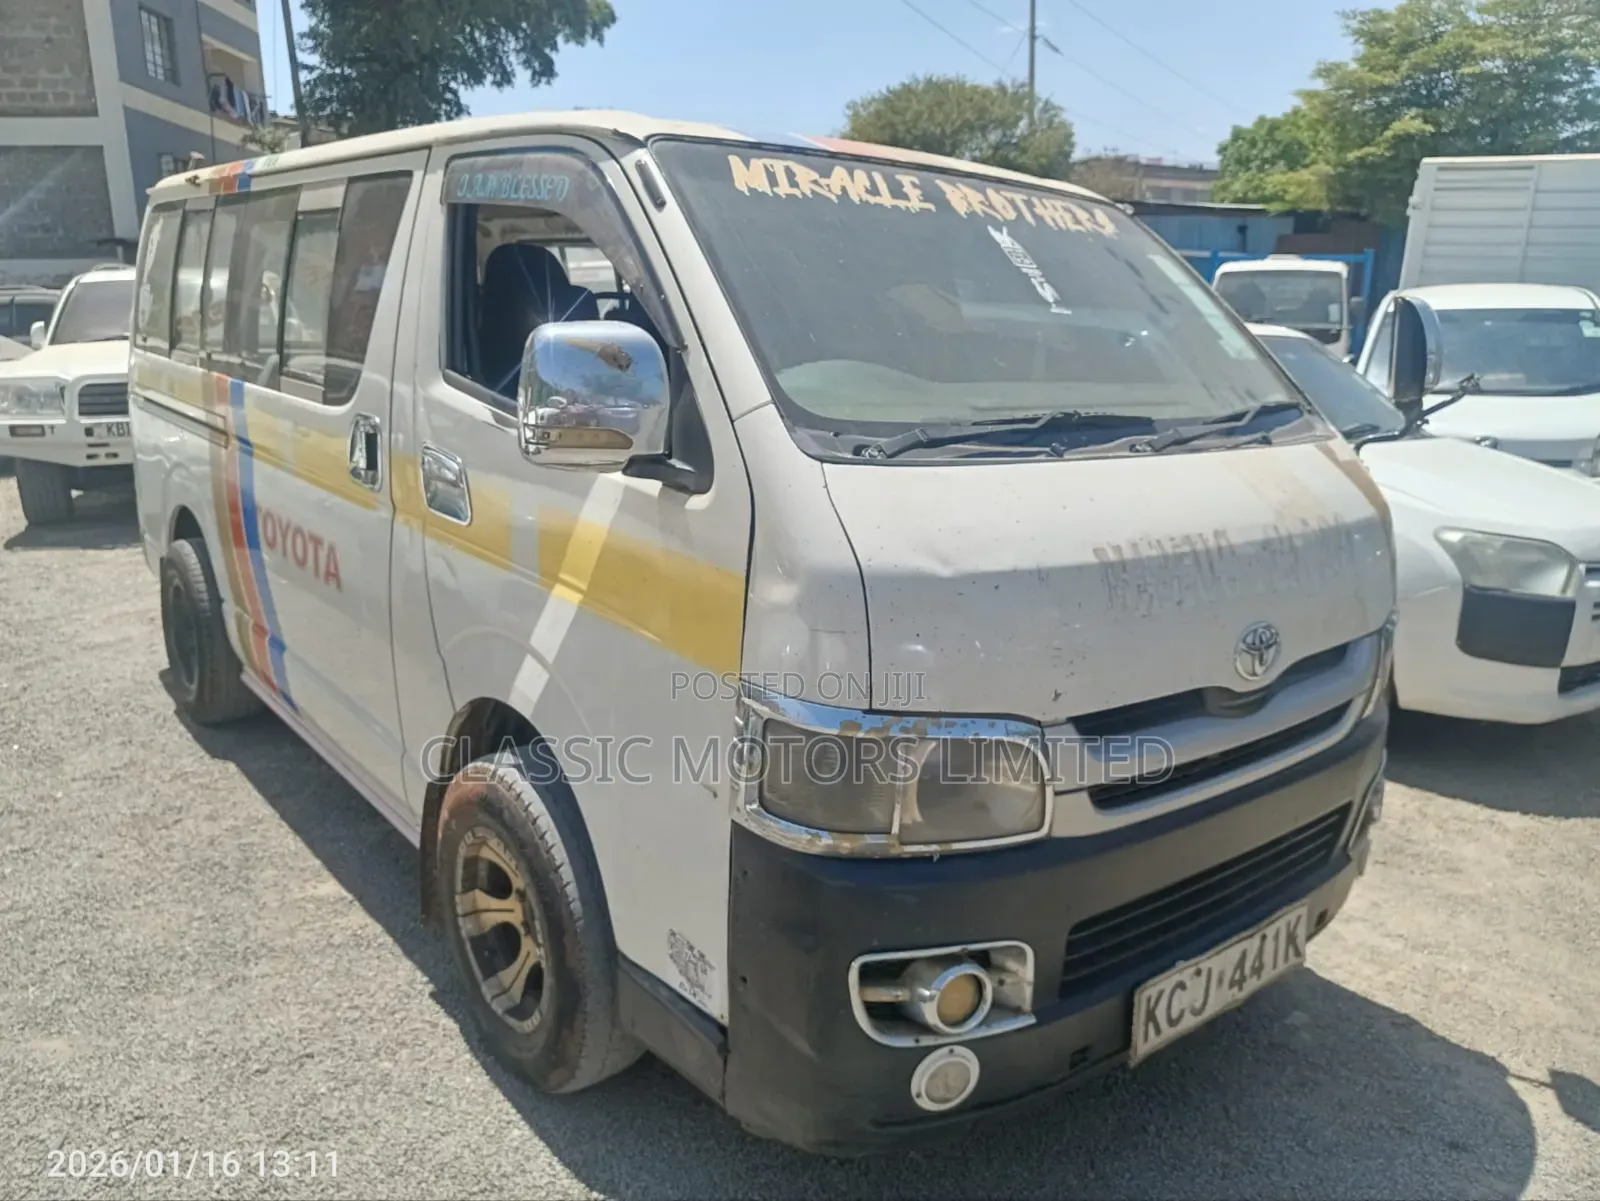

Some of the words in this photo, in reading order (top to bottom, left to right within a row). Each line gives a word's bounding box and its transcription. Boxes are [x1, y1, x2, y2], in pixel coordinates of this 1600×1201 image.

[727, 155, 936, 213] MIRACLE
[257, 504, 343, 592] OYOTA
[1143, 966, 1213, 1044] KCJ
[1228, 914, 1303, 992] 441K
